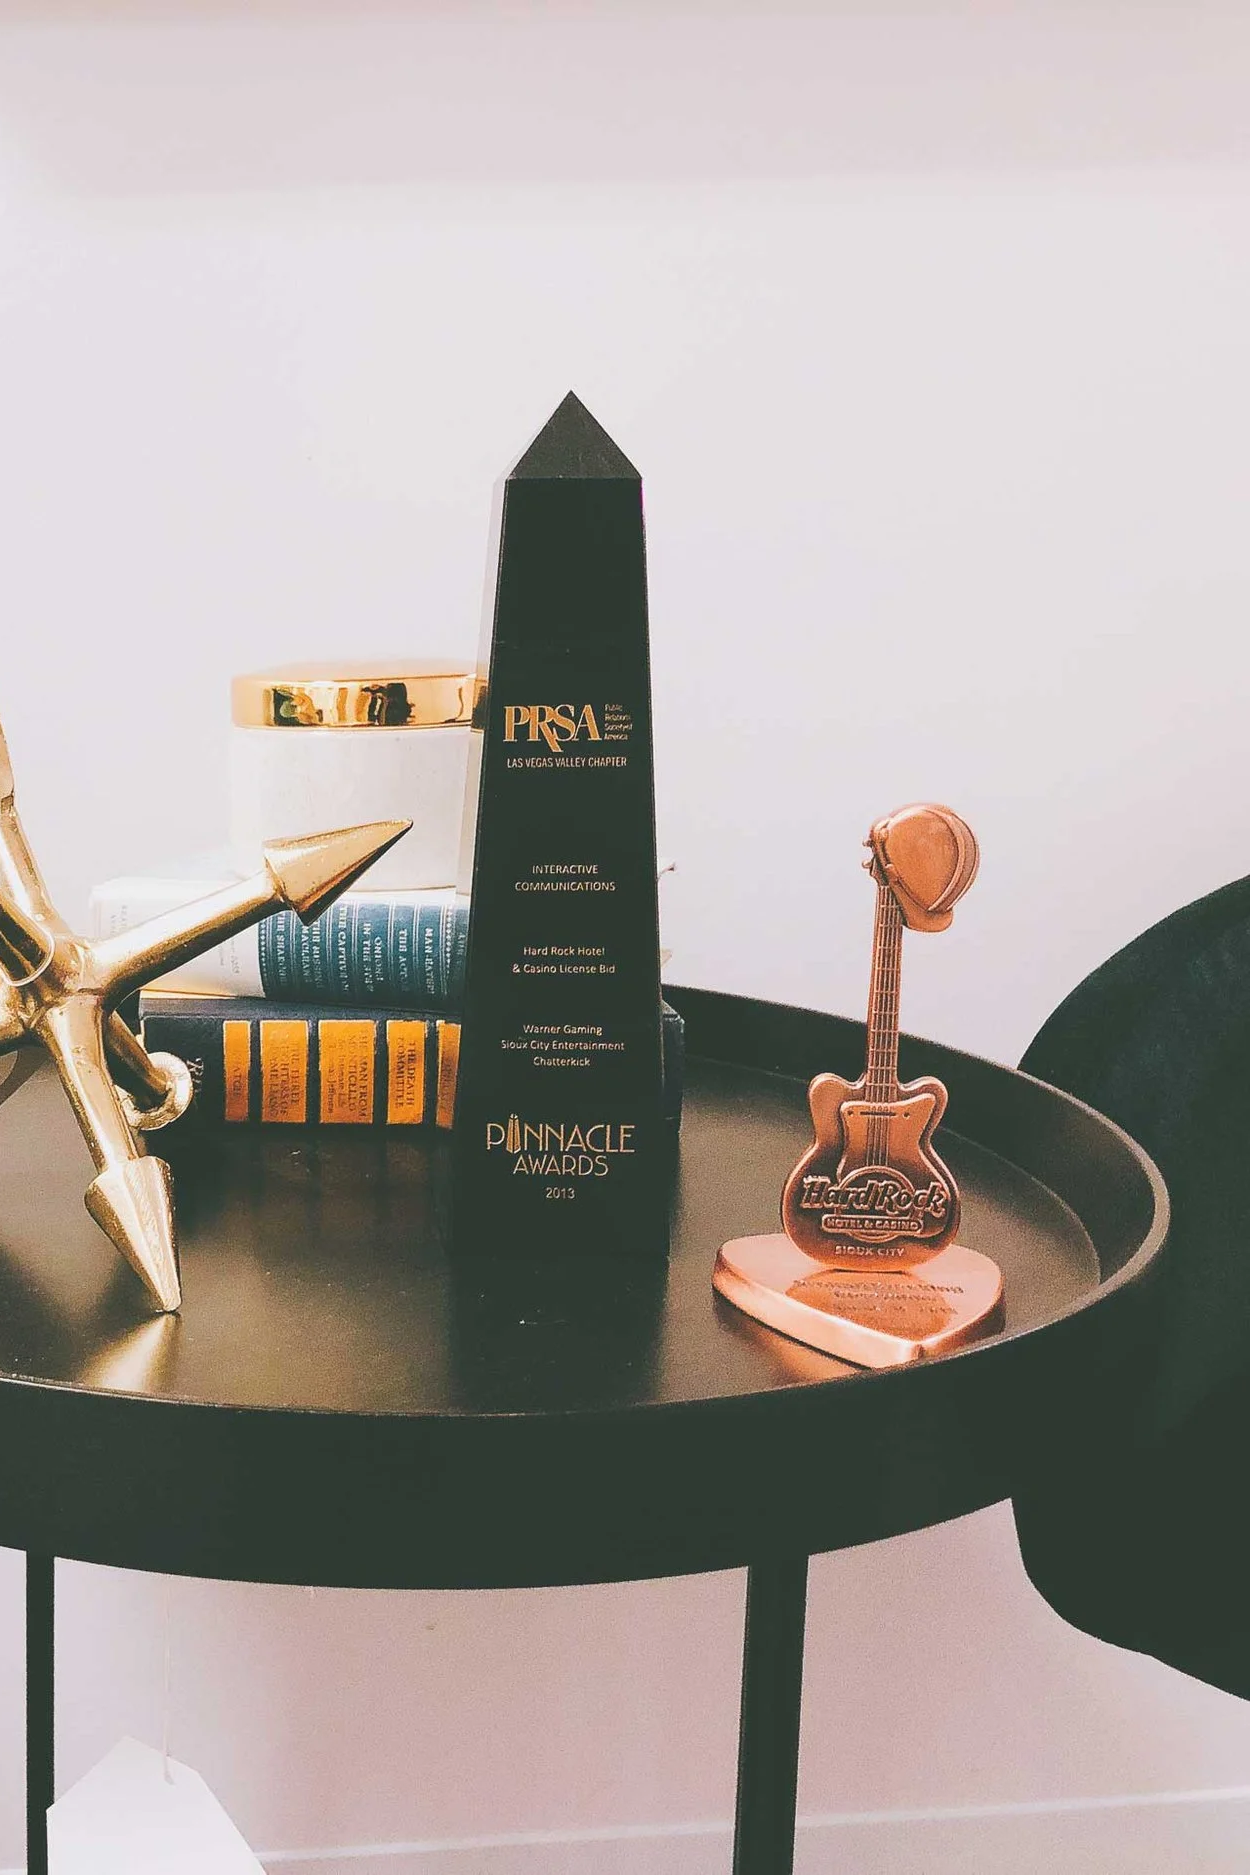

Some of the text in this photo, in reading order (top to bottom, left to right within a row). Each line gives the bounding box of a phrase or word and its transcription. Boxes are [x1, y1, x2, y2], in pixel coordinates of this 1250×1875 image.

[503, 704, 602, 752] PRSA
[507, 756, 627, 768] LAS VEGAS VALLEY CHAPTER
[532, 864, 598, 874] INTERACTIVE
[515, 881, 616, 891] COMMUNICATIONS
[363, 922, 372, 935] IN
[399, 928, 408, 952] THE
[523, 946, 605, 956] Hard Rock Hotel
[512, 963, 616, 973] & Casino License Bid
[523, 1024, 603, 1036] Warner Gaming
[501, 1039, 625, 1051] Sioux City Entertainment
[533, 1056, 591, 1066] Chatterkick
[359, 1055, 368, 1081] MAN
[395, 1037, 406, 1108] COMMITTEE
[406, 1041, 416, 1106] THE DEATH
[359, 1085, 368, 1117] FROM
[486, 1114, 635, 1154] PINNACLE
[512, 1154, 609, 1177] AWARDS
[545, 1187, 575, 1199] 2013
[801, 1175, 947, 1218] Hard Rock
[826, 1218, 919, 1231] HOTEL & CASINO
[835, 1245, 905, 1257] SIOUX CITY
